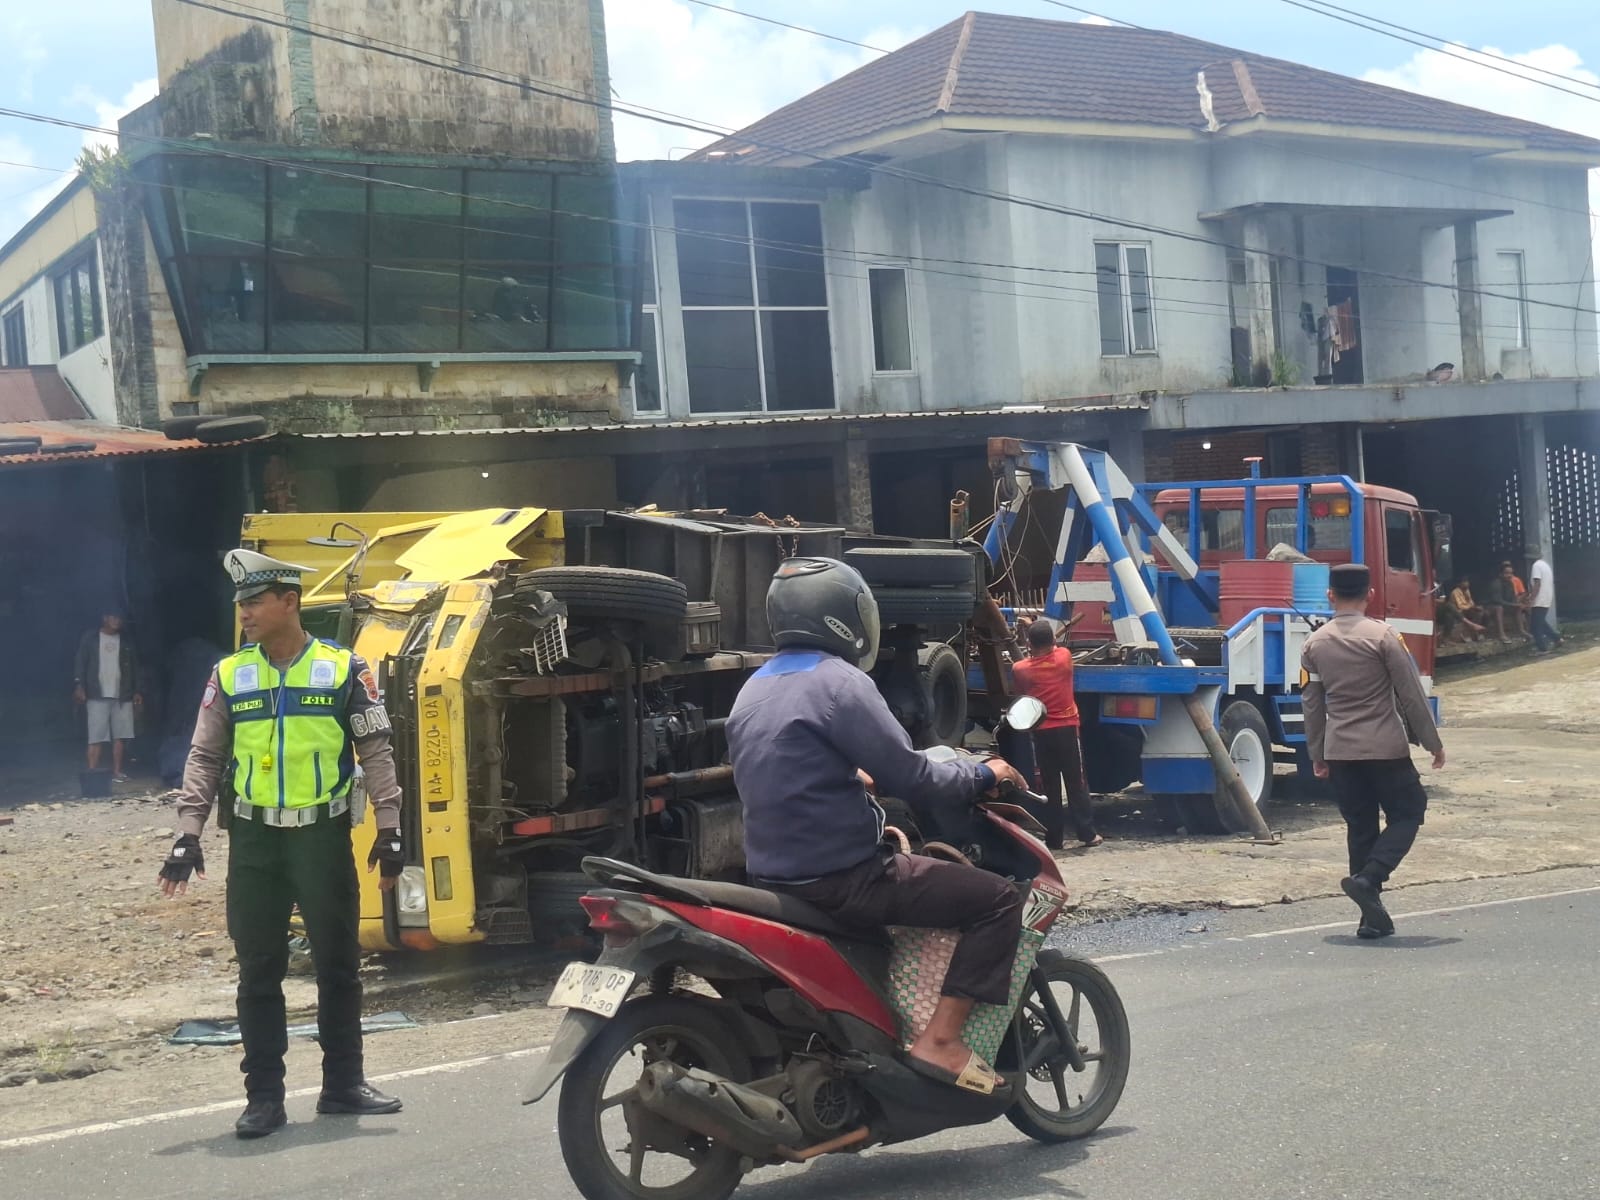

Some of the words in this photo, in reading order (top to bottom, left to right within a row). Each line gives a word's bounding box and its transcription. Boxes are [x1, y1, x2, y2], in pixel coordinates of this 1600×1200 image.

[302, 696, 335, 705] POLRI
[426, 729, 441, 767] 8220
[428, 777, 442, 794] AA
